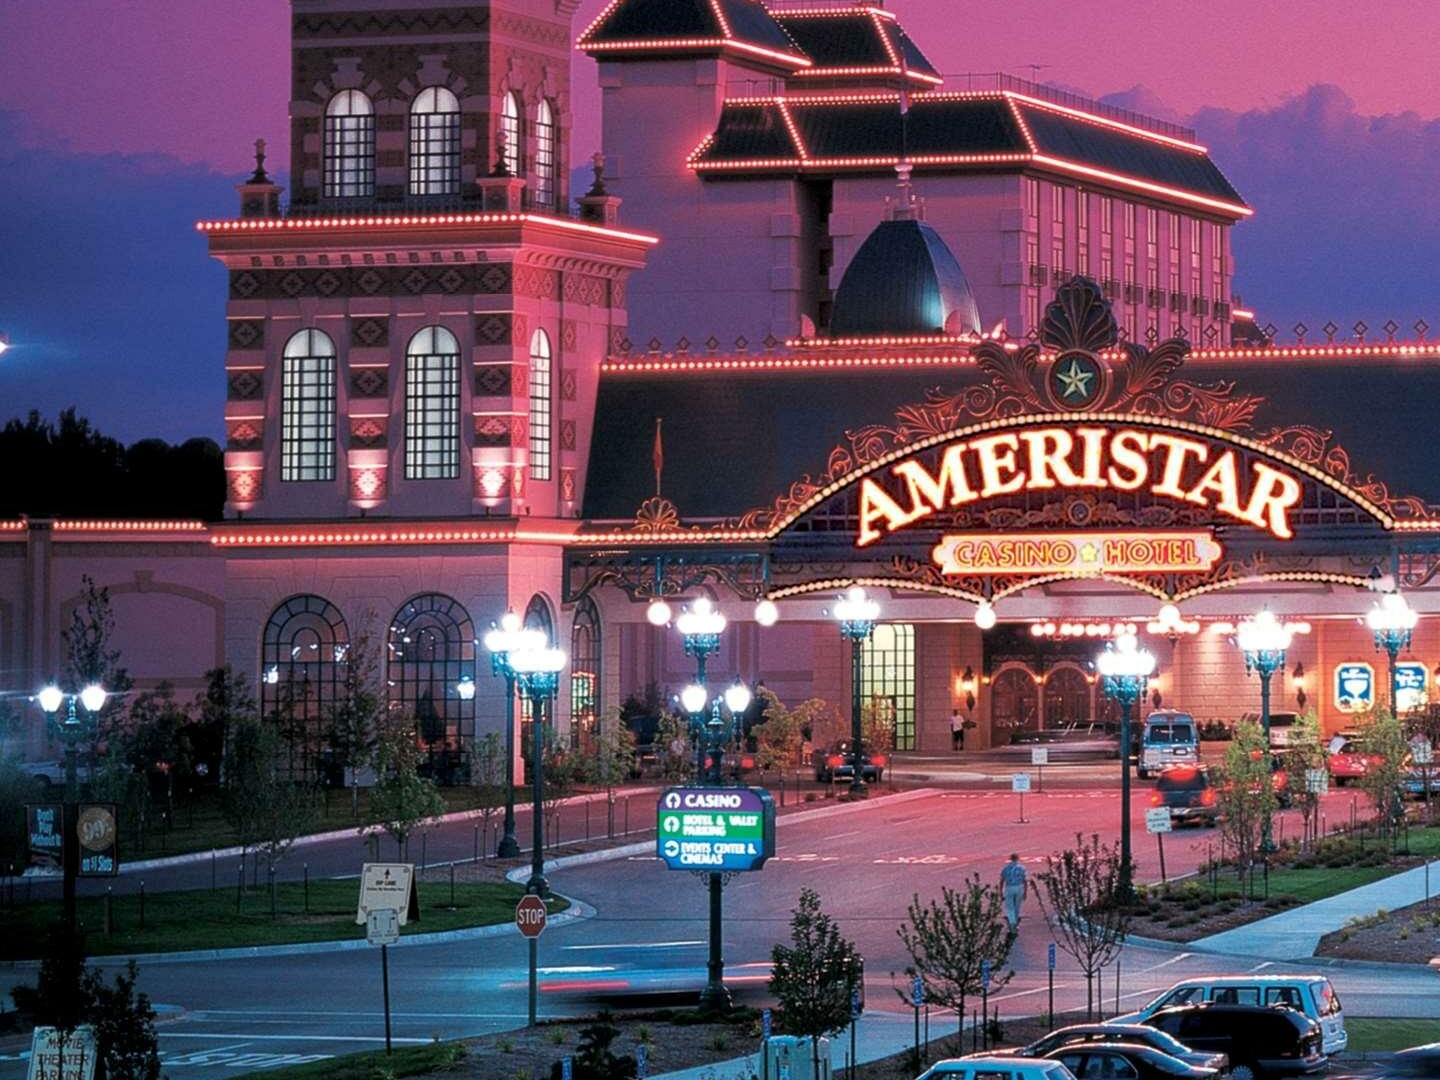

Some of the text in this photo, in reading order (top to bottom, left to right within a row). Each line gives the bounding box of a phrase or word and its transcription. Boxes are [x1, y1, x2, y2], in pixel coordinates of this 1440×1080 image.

[857, 427, 1302, 547] AMERISTAR
[953, 539, 1203, 568] CASINO HOTEL
[685, 794, 742, 808] CASINO
[682, 814, 758, 826] HOTEL & VALET
[682, 825, 727, 837] PARKING
[681, 842, 757, 854] EVENTS CENTER &
[680, 854, 724, 864] CINEMAS
[518, 908, 544, 925] STOP
[47, 1038, 83, 1049] MOVIE
[37, 1053, 89, 1066] THEATER
